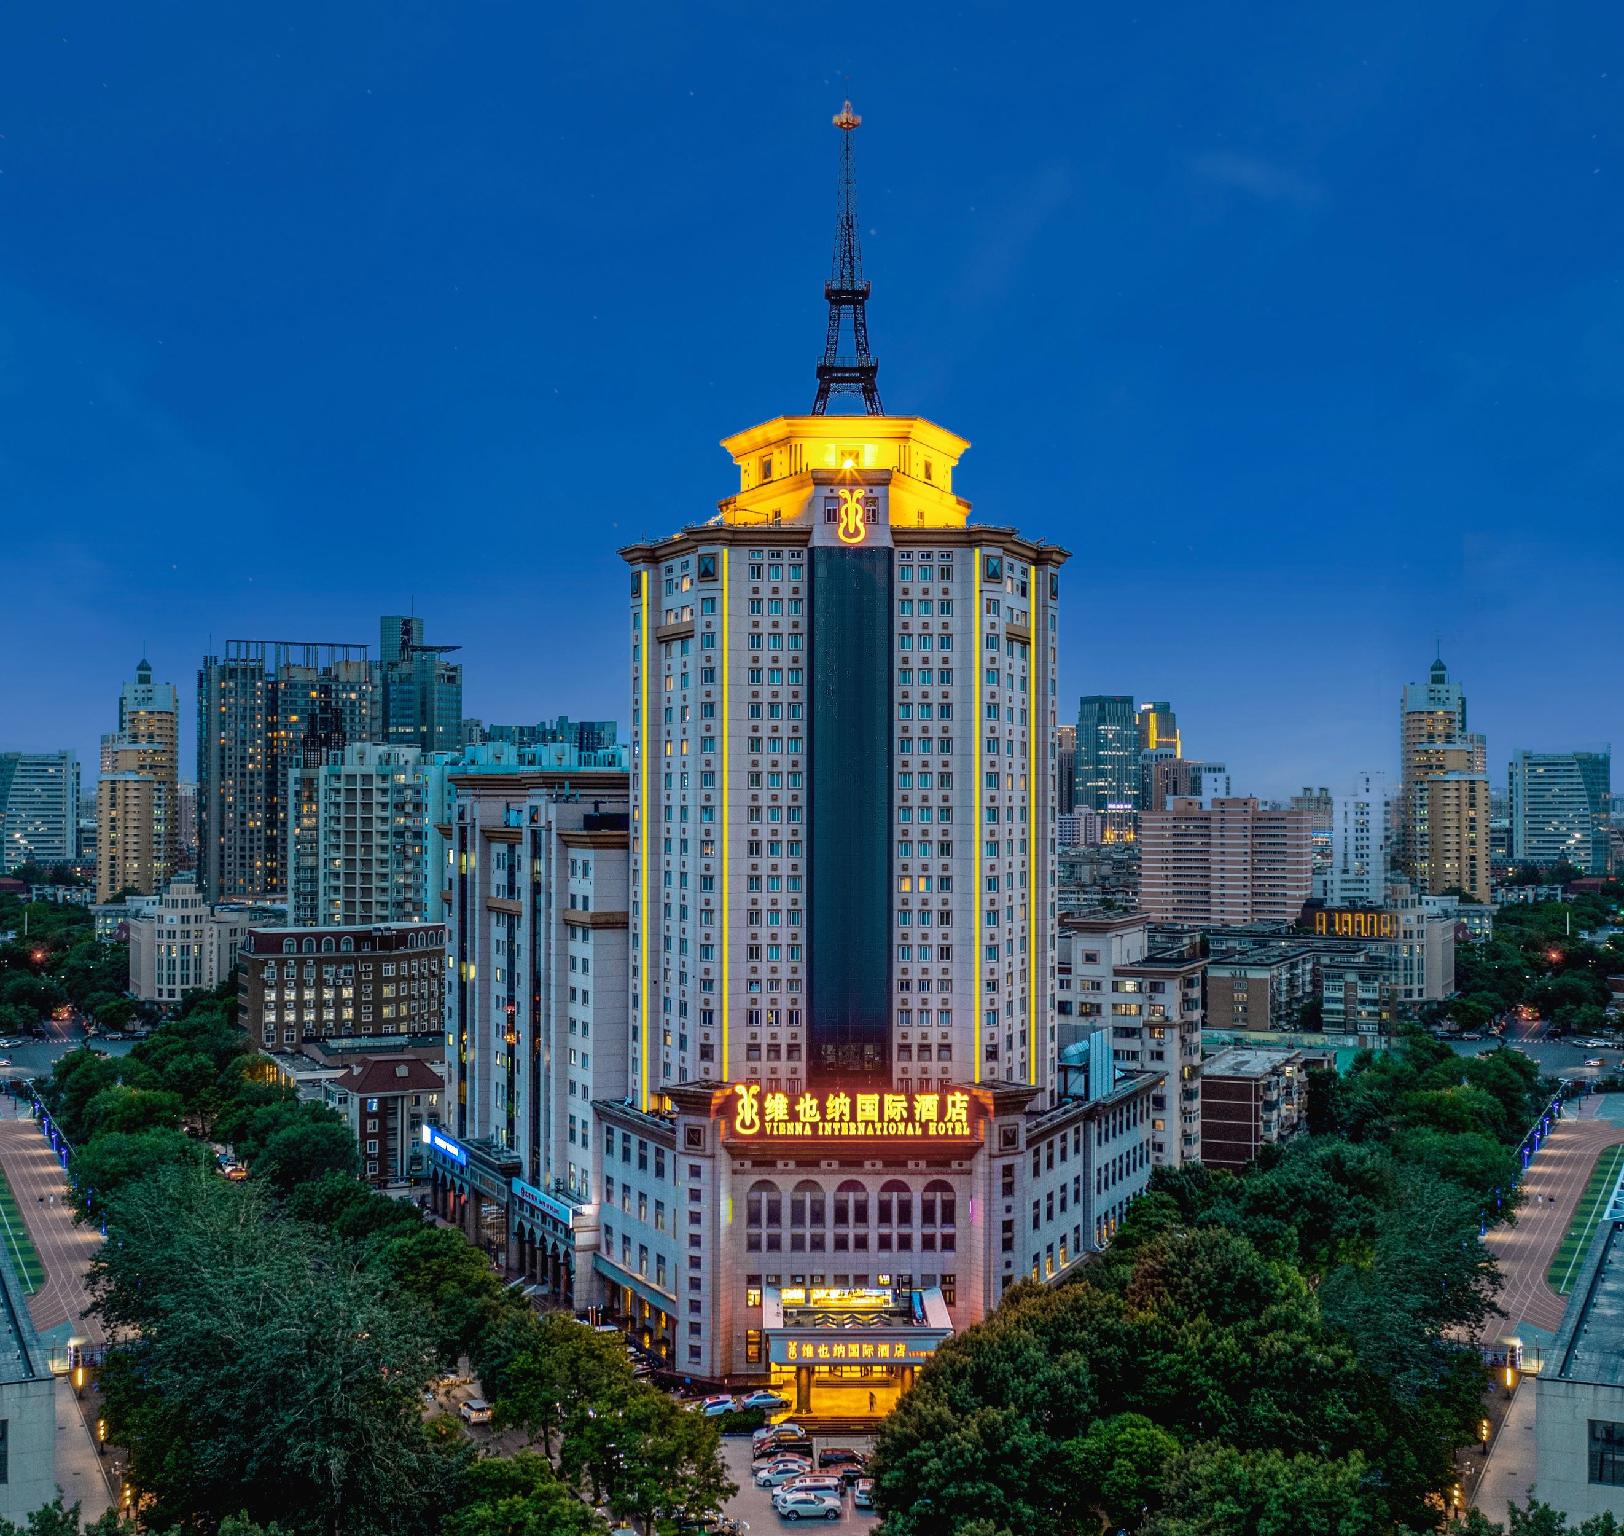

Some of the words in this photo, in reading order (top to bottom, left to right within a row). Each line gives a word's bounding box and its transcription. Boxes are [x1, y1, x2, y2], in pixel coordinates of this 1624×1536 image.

[764, 1091, 970, 1122] 维也纳国际酒店
[764, 1122, 812, 1136] VIENNA
[818, 1122, 922, 1136] INTERNATIONAL
[928, 1122, 970, 1136] HOTEL
[801, 1343, 906, 1359] 维也纳国际酒店
